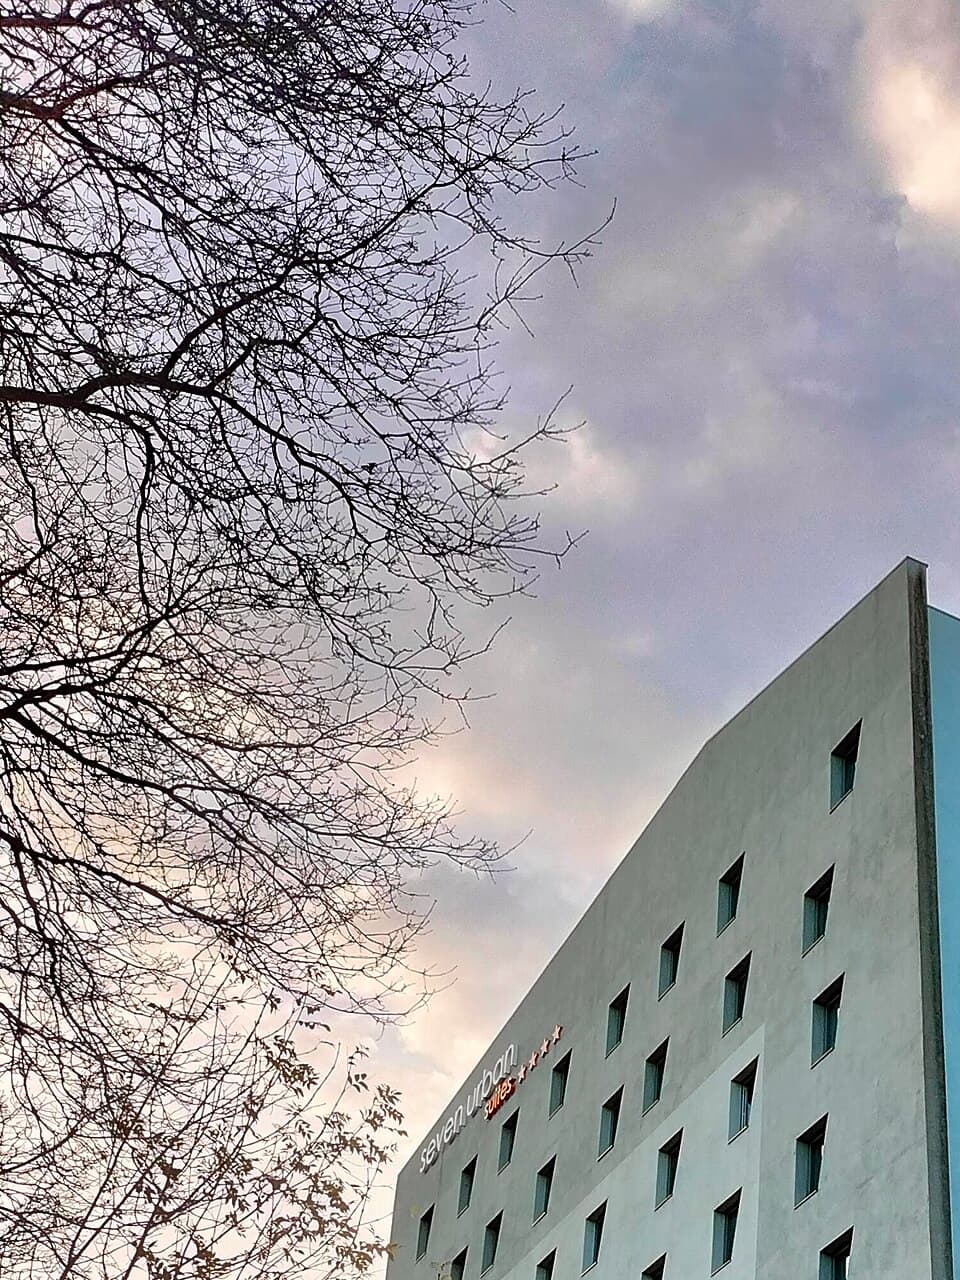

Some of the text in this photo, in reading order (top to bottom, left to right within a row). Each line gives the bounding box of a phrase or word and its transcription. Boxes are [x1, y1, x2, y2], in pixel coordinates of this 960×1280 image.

[419, 1043, 518, 1174] seven urban
[484, 1076, 517, 1121] suites
